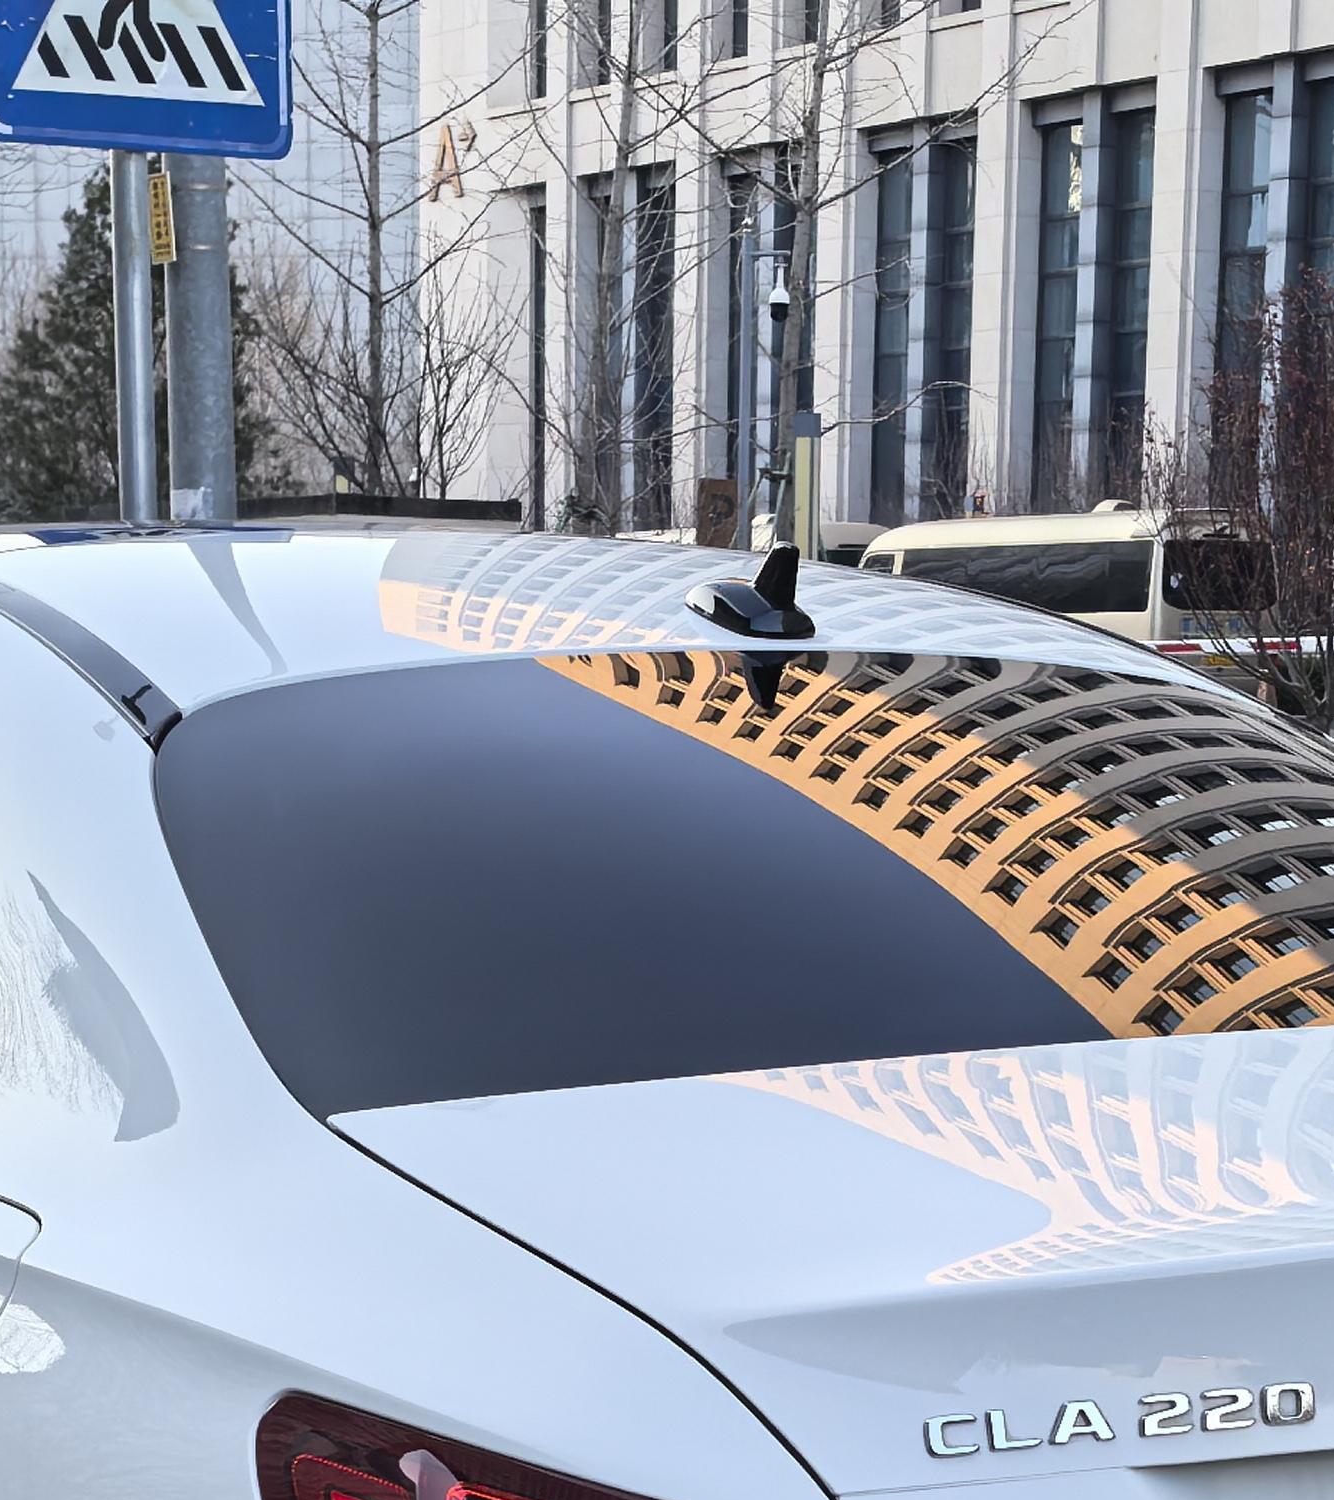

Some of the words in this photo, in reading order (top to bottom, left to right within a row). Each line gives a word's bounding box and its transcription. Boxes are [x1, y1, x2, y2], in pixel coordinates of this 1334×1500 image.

[427, 123, 464, 202] A
[923, 1399, 1116, 1459] CLA
[1138, 1382, 1317, 1438] 220
